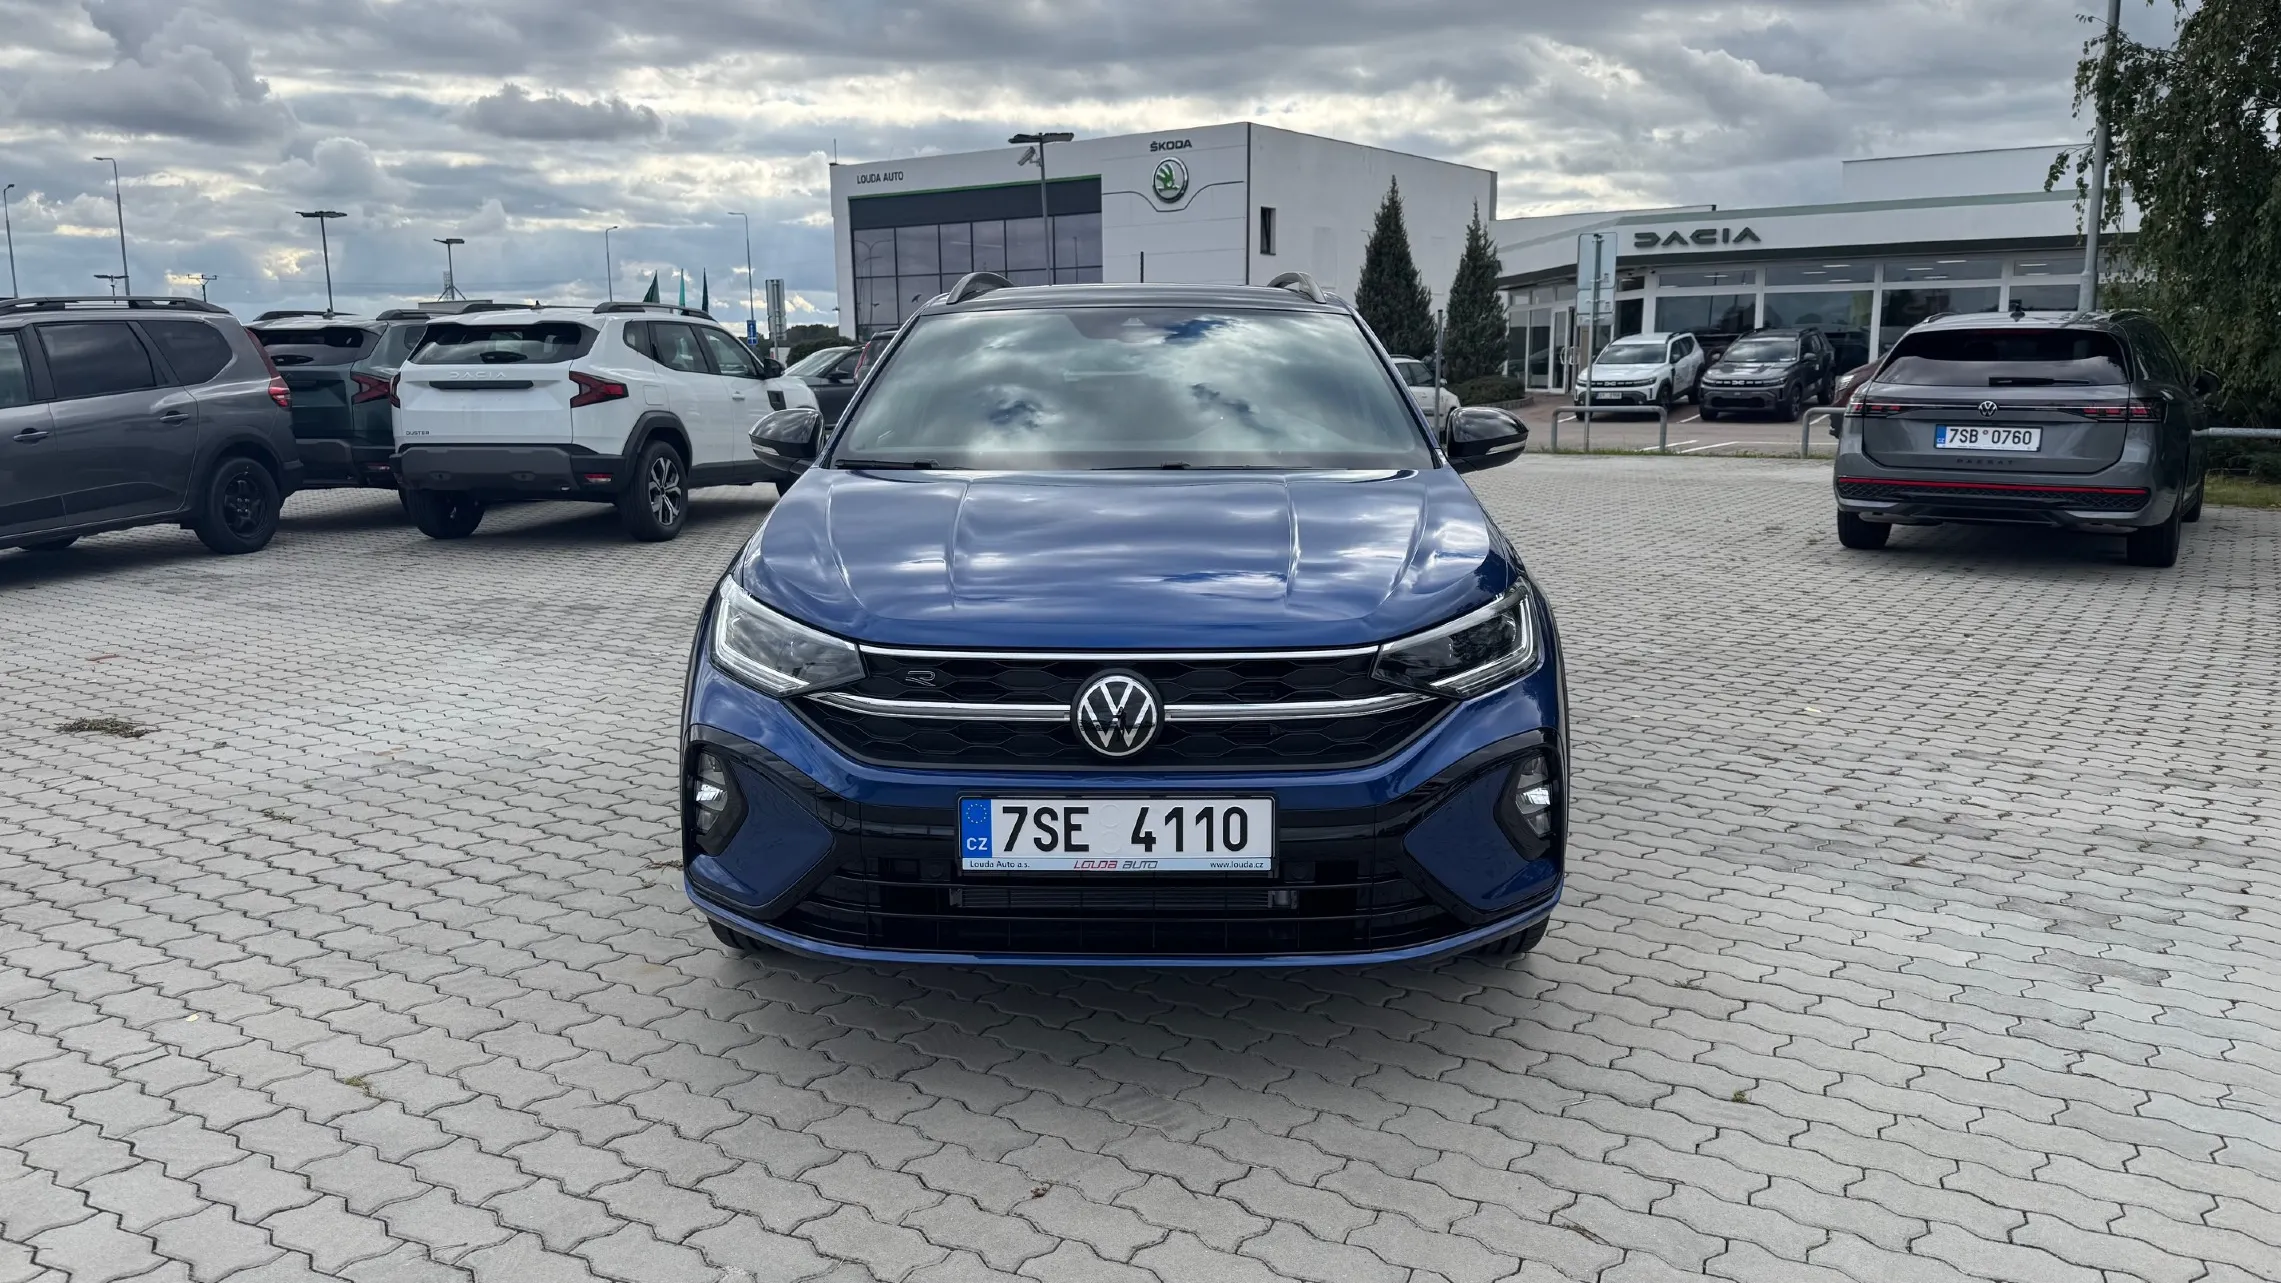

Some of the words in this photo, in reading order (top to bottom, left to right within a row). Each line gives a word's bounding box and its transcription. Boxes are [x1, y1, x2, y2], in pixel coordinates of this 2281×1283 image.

[1150, 139, 1192, 152] ŠKODA
[857, 173, 881, 184] LOUDA
[883, 171, 904, 182] AUTO
[1634, 227, 1761, 247] DACIA
[1949, 428, 1979, 444] 7SB
[1991, 430, 2032, 445] 0760
[1002, 806, 1090, 853] 7SE
[1131, 806, 1248, 853] 4110
[966, 837, 988, 851] CZ
[970, 860, 994, 868] Louda
[996, 860, 1015, 868] Auto
